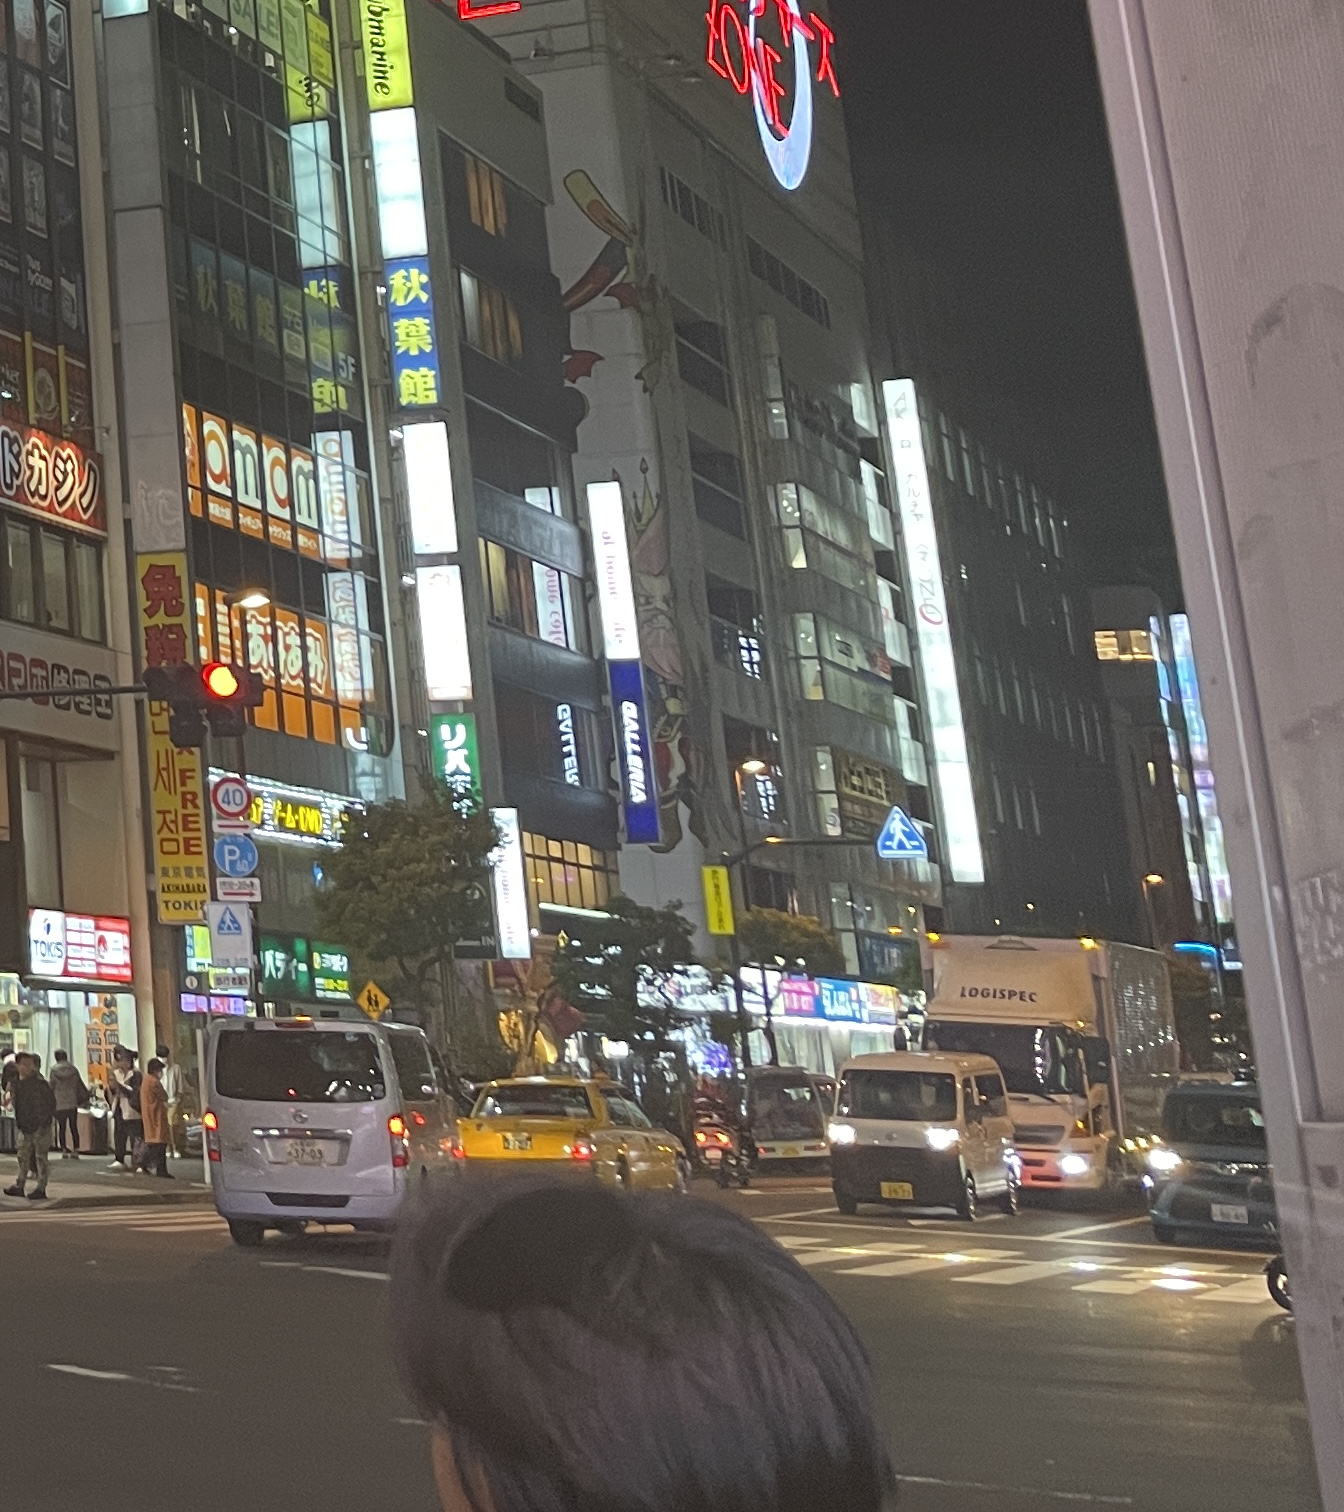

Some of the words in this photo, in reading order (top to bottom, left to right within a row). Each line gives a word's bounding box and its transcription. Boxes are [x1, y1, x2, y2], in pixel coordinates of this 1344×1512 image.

[388, 269, 439, 406] 秋葉館
[621, 700, 647, 804] GALLERIA
[178, 768, 203, 855] FREE
[221, 788, 244, 807] 40
[960, 986, 1038, 1004] LOGISPEC
